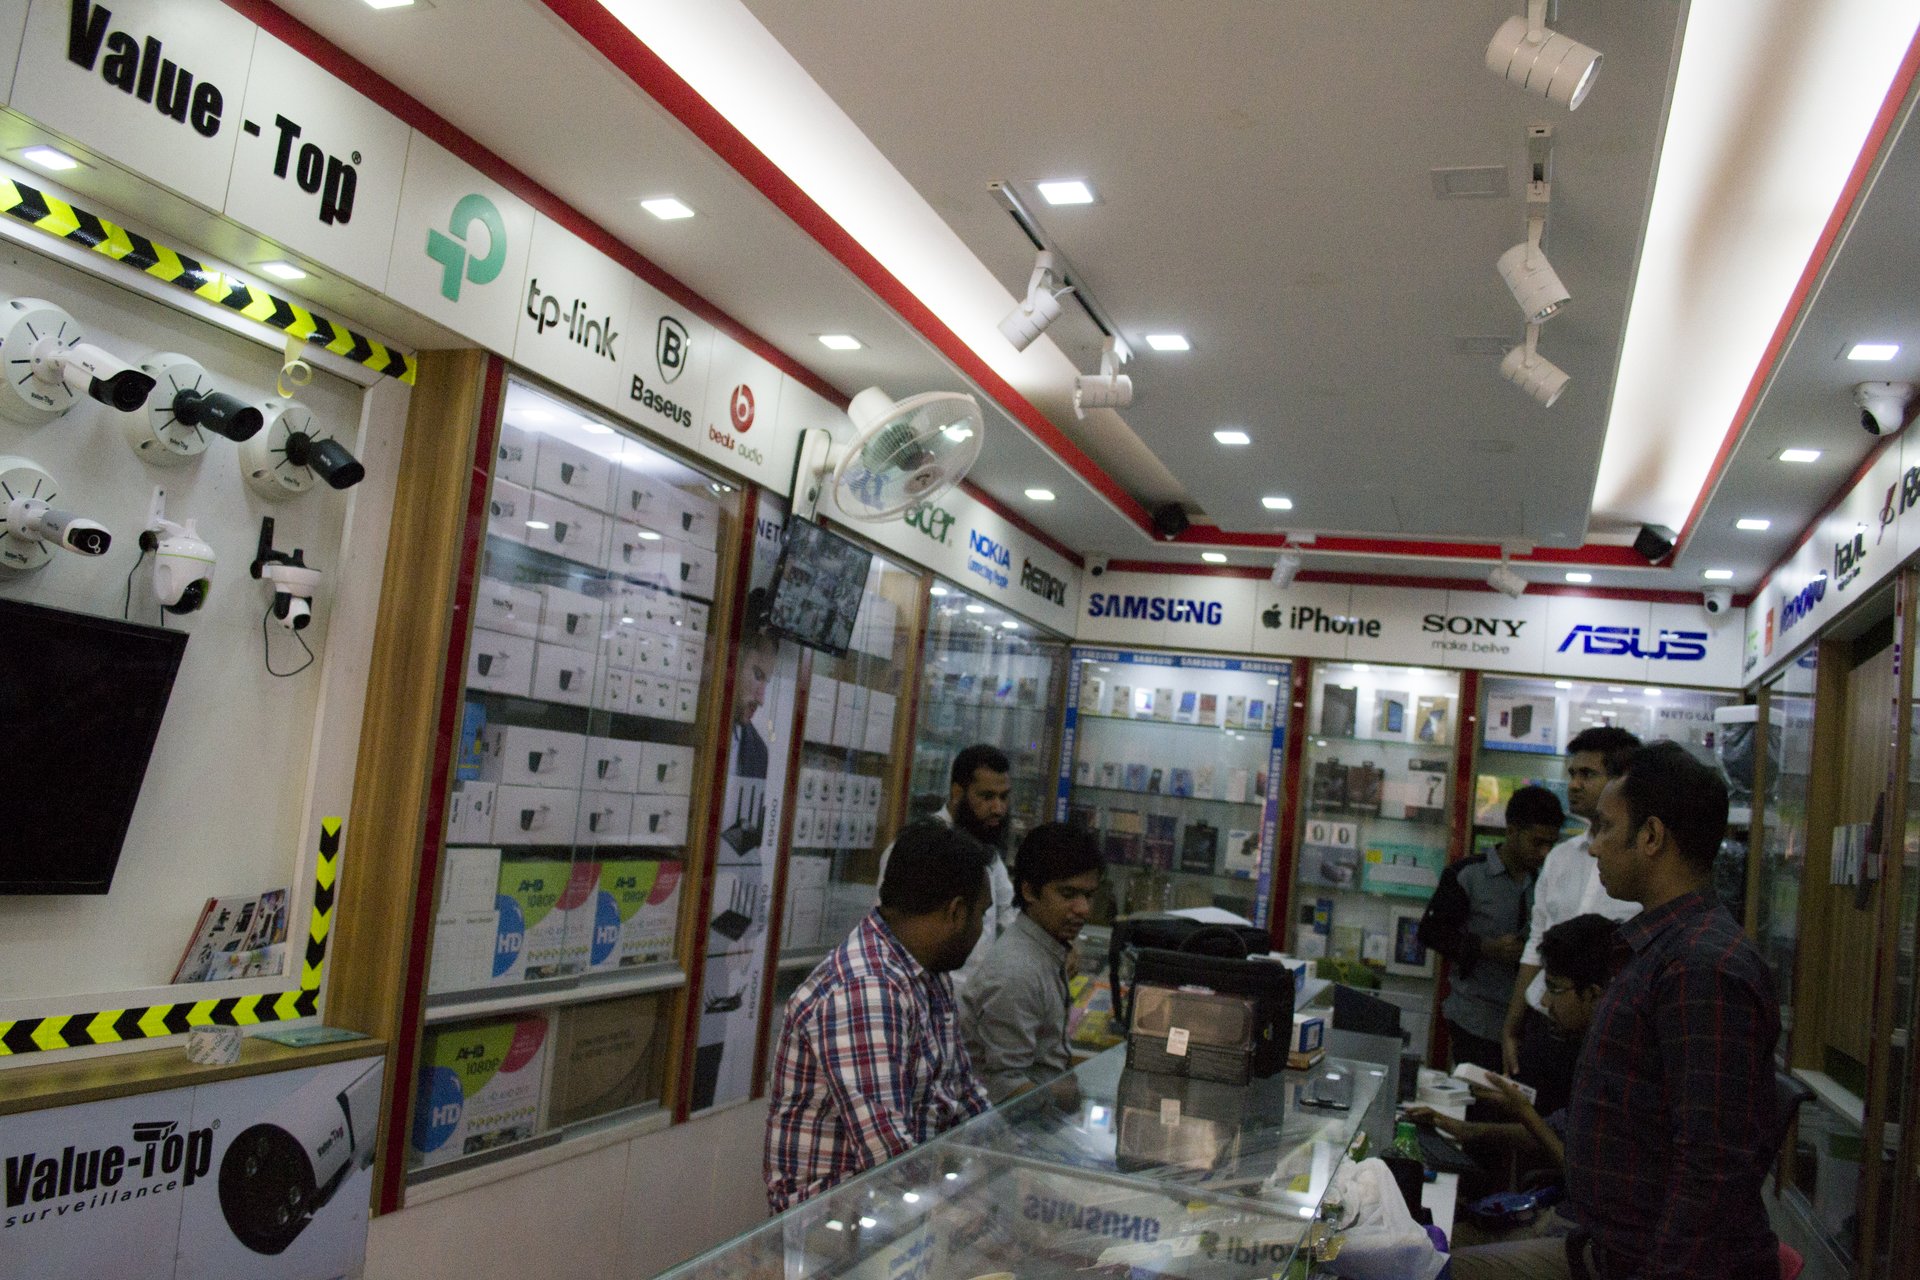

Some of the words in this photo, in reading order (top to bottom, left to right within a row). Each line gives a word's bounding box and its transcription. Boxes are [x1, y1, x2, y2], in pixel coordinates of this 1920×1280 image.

[67, 0, 224, 138] Value
[526, 278, 619, 362] tp-link
[630, 374, 692, 428] Baseus
[709, 424, 735, 450] beats
[904, 502, 955, 543] acer
[969, 528, 1010, 571] NOKIA
[1021, 557, 1068, 608] REMAX
[1088, 593, 1223, 626] SAMSUNG
[1290, 606, 1381, 637] iPhone
[1422, 613, 1527, 638] SONY
[1556, 625, 1708, 661] ASUS
[497, 932, 522, 954] HD
[597, 925, 620, 944] HD
[432, 1104, 462, 1127] HD
[5, 1121, 214, 1208] Value-Top
[4, 1178, 178, 1228] surveillance
